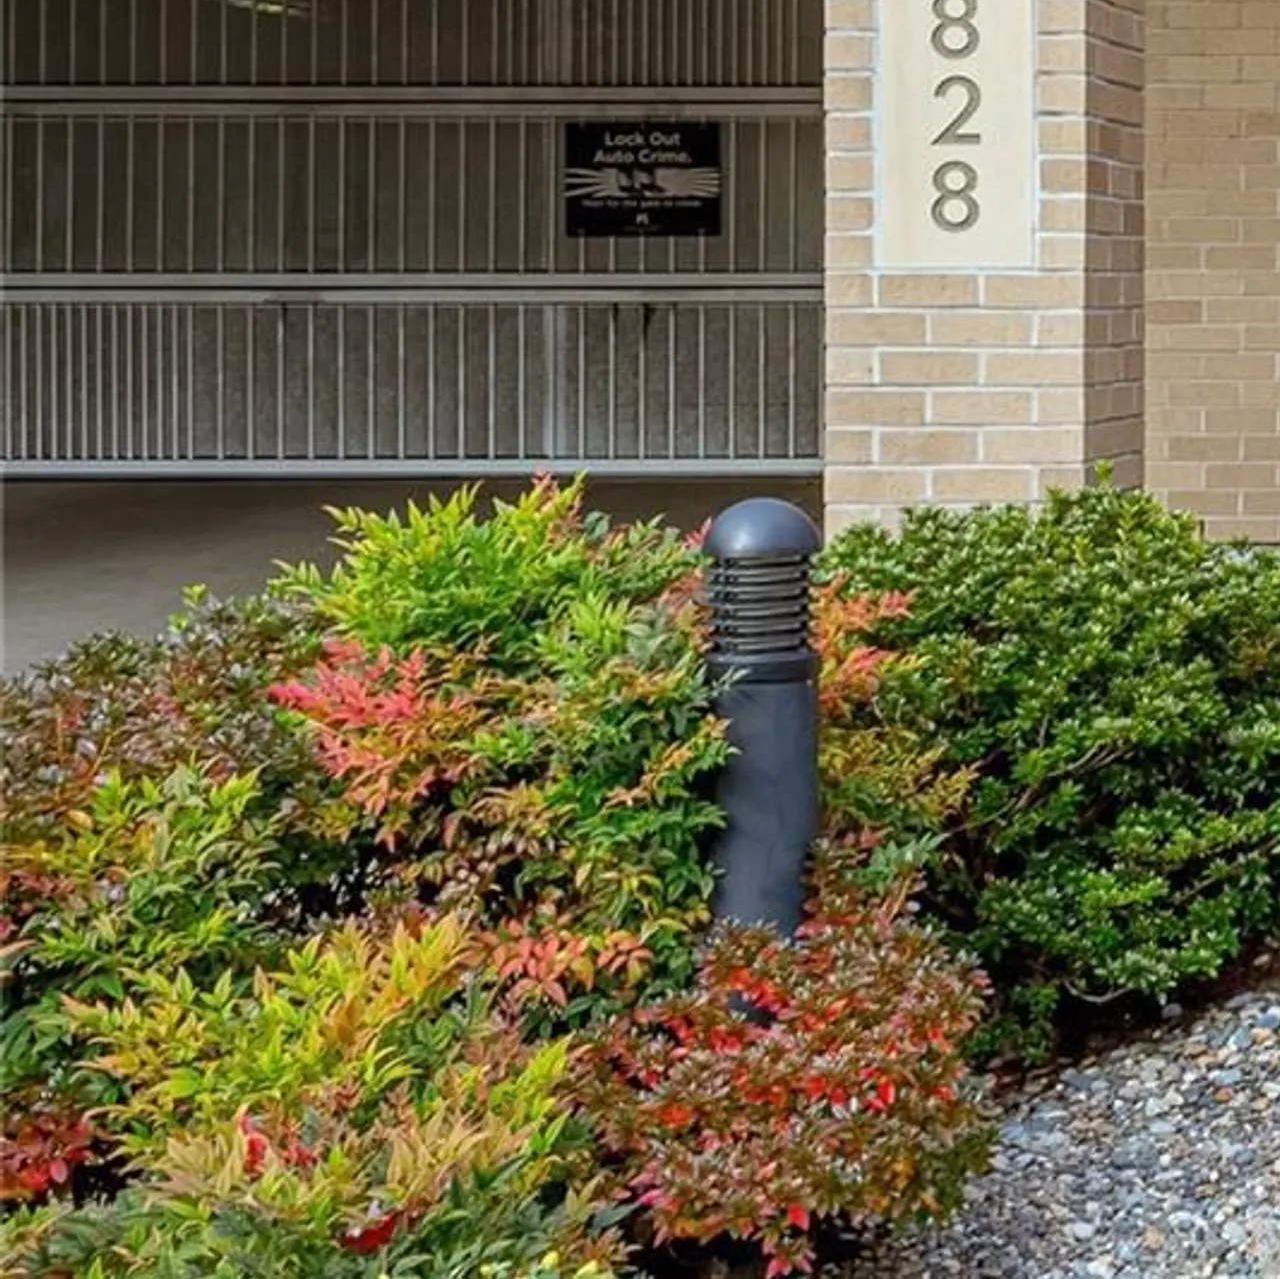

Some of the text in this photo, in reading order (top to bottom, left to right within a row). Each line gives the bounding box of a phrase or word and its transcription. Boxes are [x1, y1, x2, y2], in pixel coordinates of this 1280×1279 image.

[604, 130, 681, 146] Lock Out
[592, 149, 634, 164] Auto
